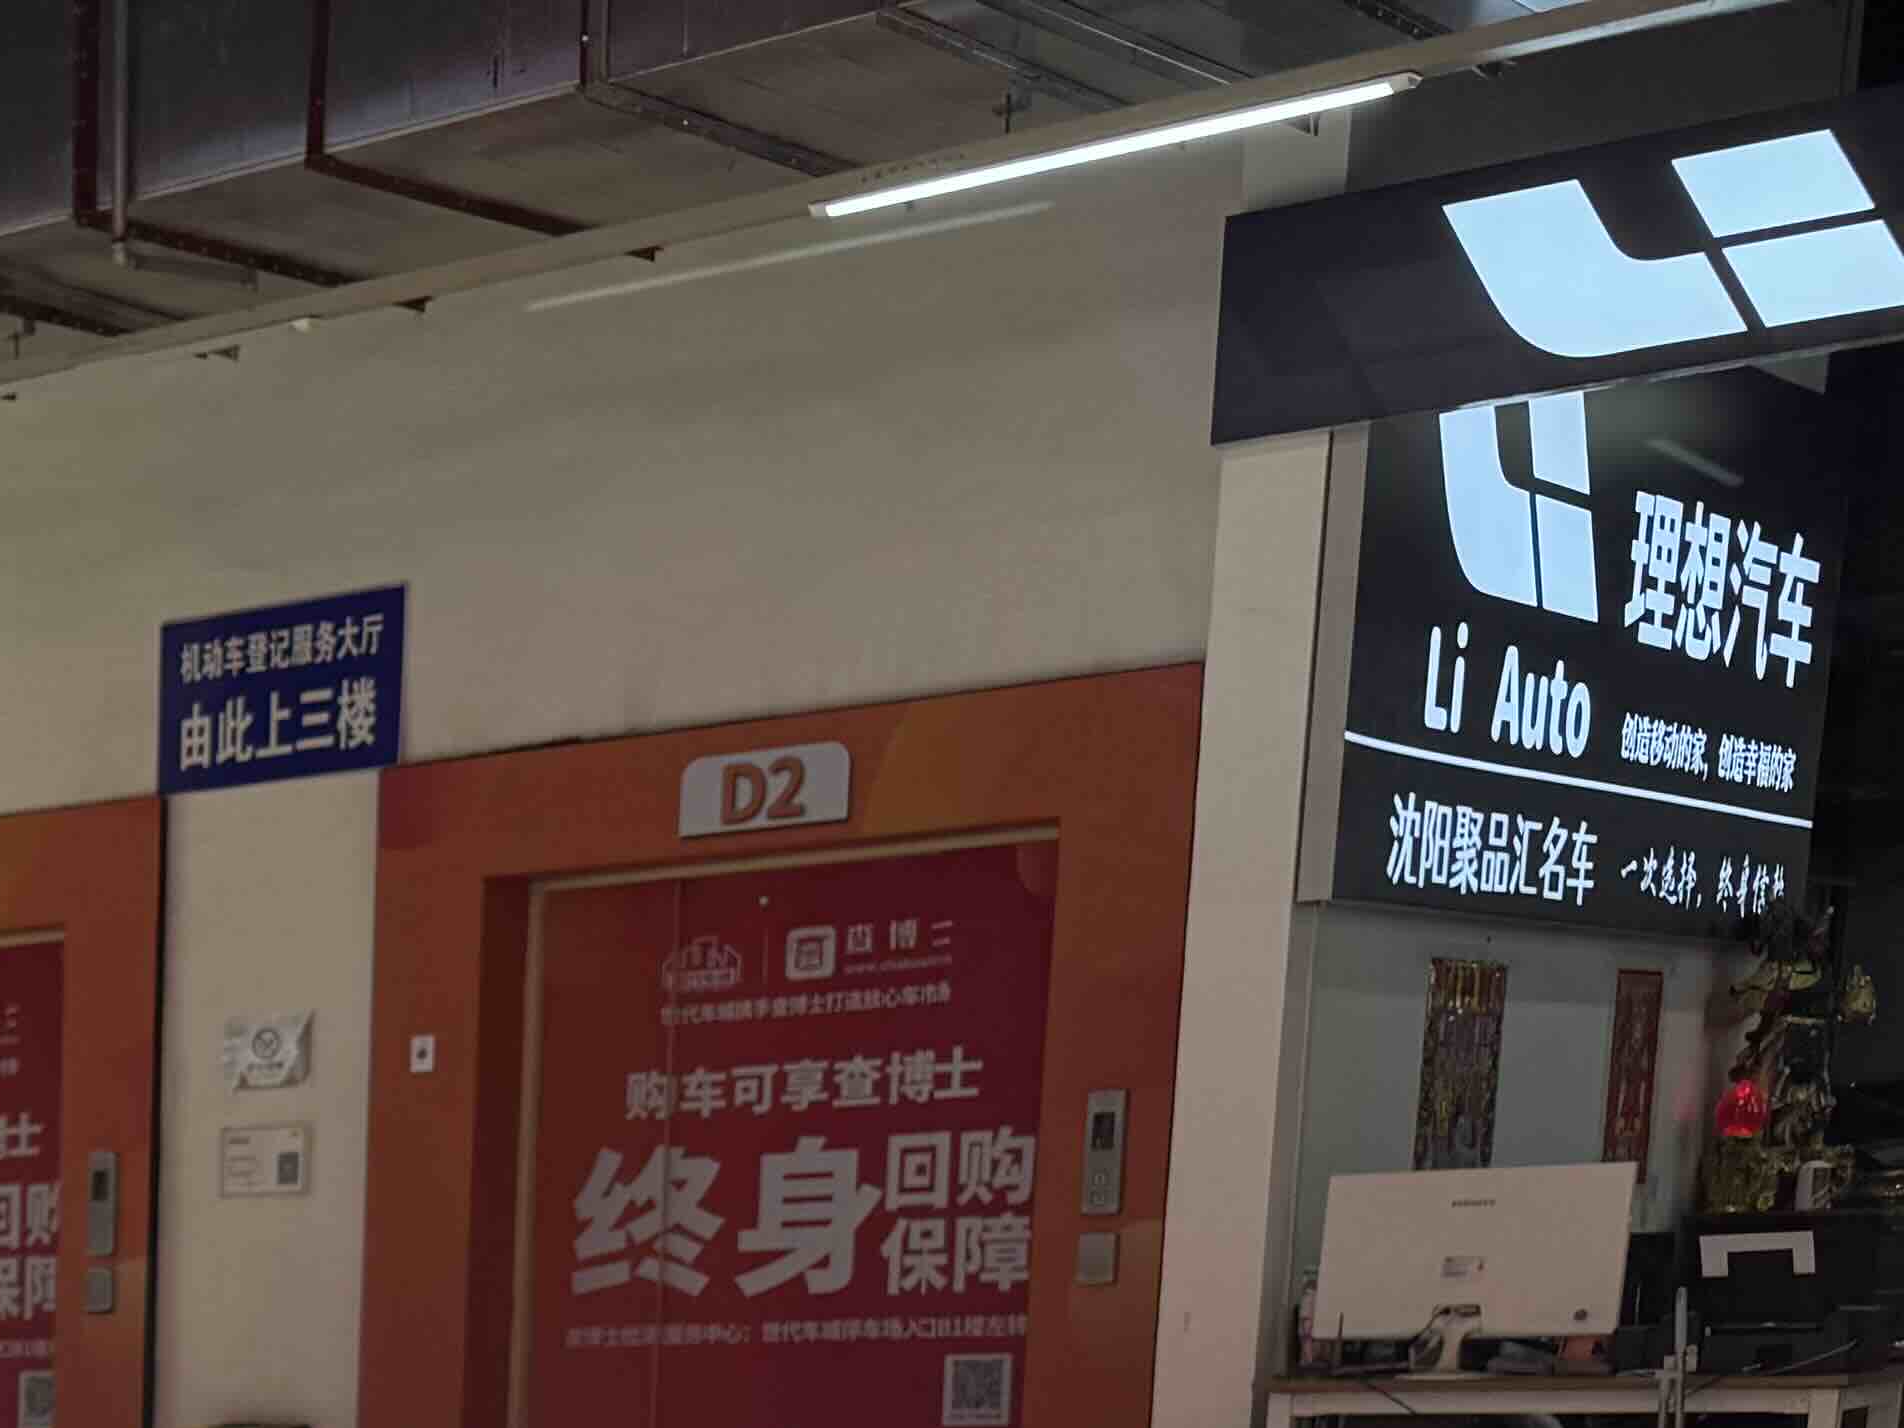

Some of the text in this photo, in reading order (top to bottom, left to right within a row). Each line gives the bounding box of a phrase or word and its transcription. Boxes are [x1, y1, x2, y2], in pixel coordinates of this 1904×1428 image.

[1624, 490, 1823, 690] 理想汽车
[179, 612, 385, 684] 机动车登记服务大厅
[1424, 622, 1592, 760] Li Auto
[178, 676, 377, 772] 由此上三楼
[719, 757, 807, 827] D2
[1386, 791, 1600, 908] 沈阳聚品汇名车
[625, 1045, 985, 1122] 购车可享查博士
[885, 1125, 1036, 1212] 回购
[572, 1136, 882, 1298] 终身
[881, 1213, 1033, 1297] 保障
